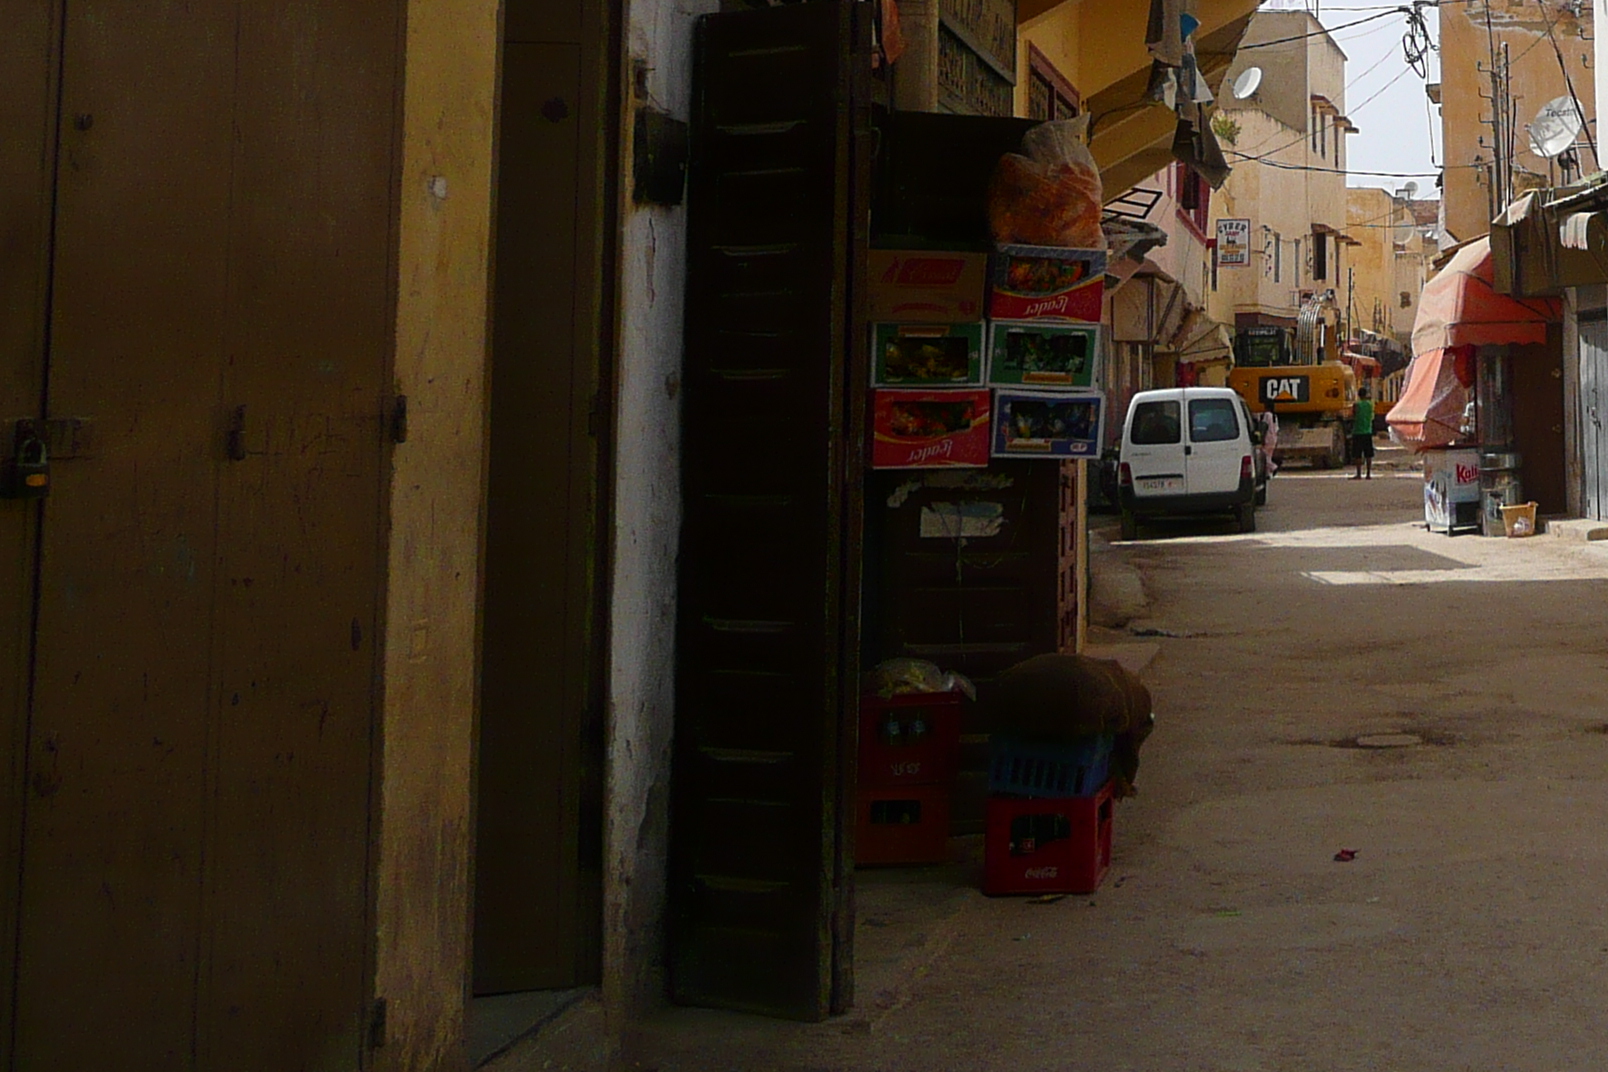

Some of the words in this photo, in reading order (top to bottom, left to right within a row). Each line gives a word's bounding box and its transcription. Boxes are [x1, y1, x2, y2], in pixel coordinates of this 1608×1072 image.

[1024, 294, 1069, 316] Leader
[1266, 378, 1300, 400] CAT
[908, 439, 952, 462] Leader
